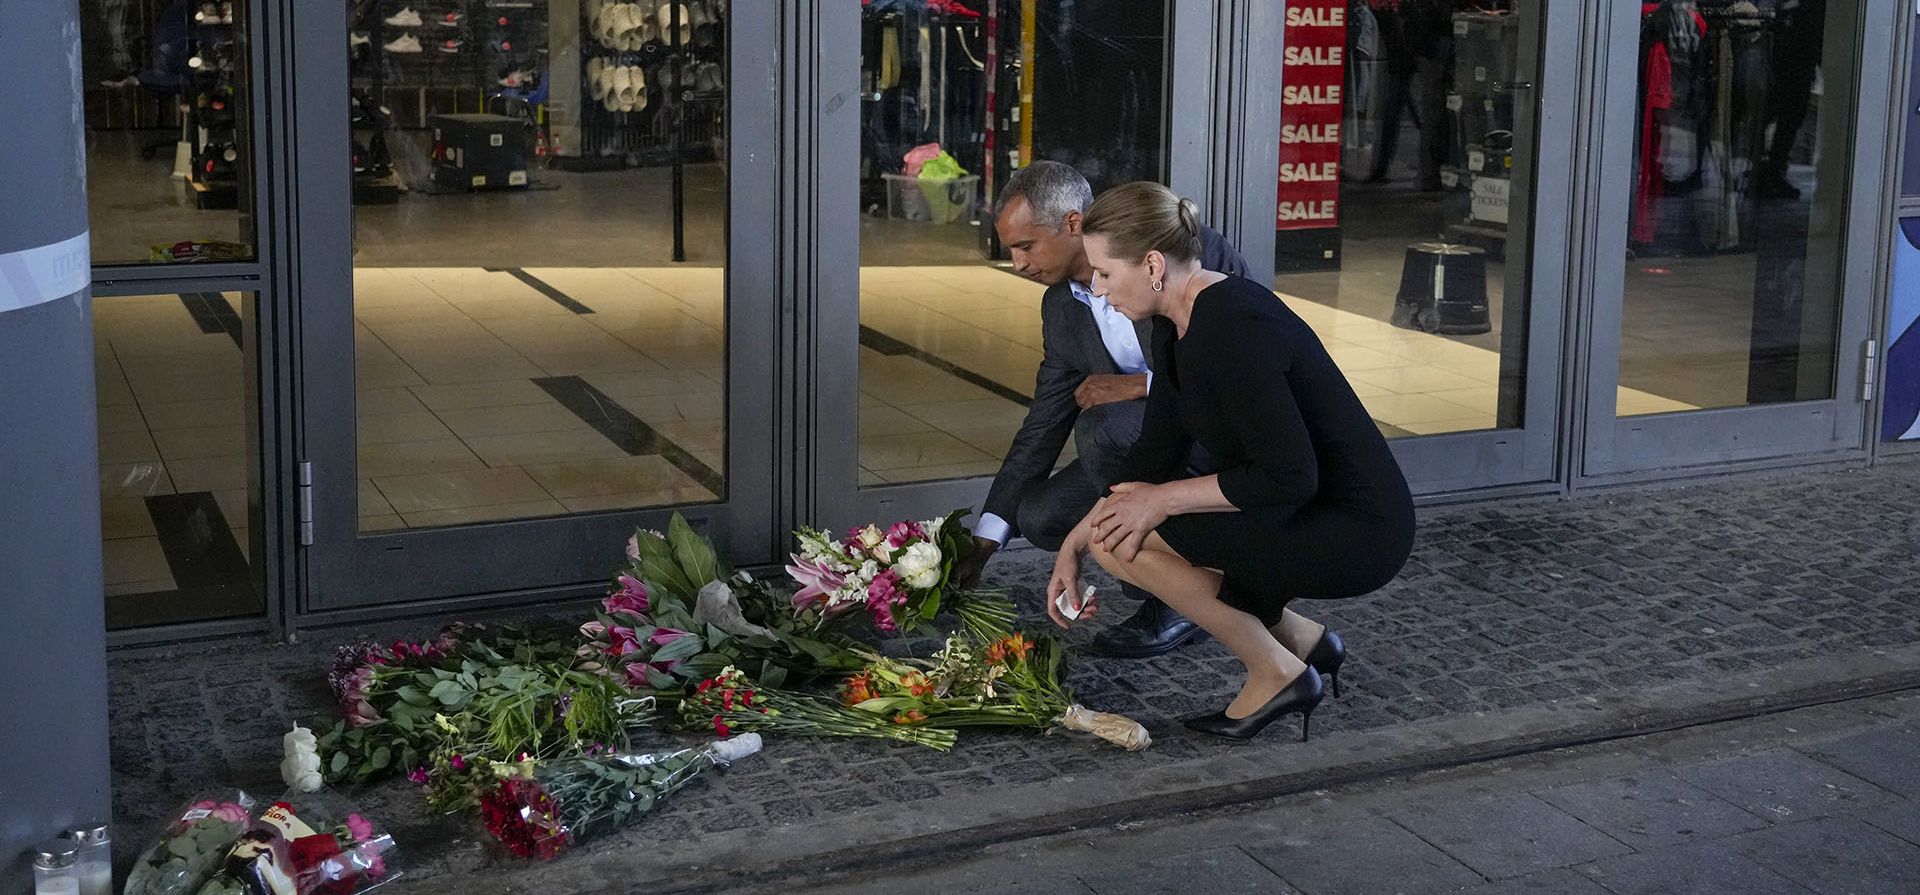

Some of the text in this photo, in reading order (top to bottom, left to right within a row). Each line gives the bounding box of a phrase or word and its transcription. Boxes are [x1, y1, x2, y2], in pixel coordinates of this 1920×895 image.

[1285, 7, 1344, 27] SALE
[1284, 46, 1343, 66] SALE
[1283, 85, 1341, 105] SALE
[1281, 124, 1339, 144] SALE
[1279, 162, 1337, 182] SALE
[1277, 200, 1335, 221] SALE
